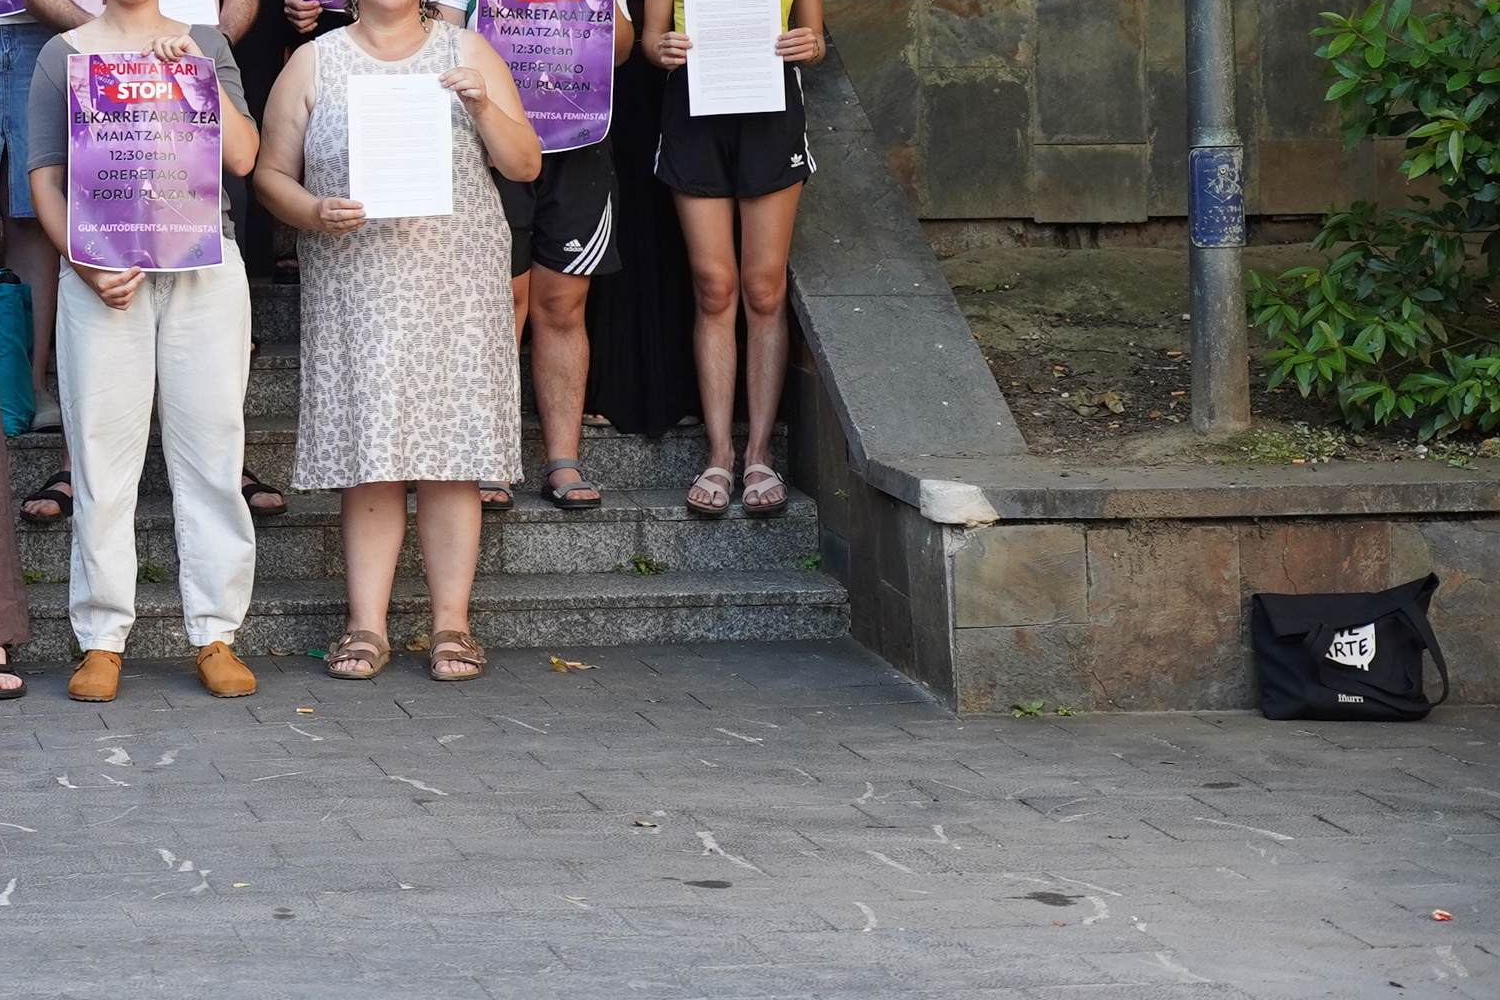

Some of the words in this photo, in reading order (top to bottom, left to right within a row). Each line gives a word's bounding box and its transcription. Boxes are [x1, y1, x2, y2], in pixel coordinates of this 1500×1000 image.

[481, 7, 613, 23] ELKARRETARATZEA
[500, 27, 571, 38] MAIATZAK
[575, 29, 591, 39] 30
[512, 44, 573, 56] 12:30etan
[117, 82, 173, 99] STOP!
[536, 80, 591, 91] PLAZAN
[74, 110, 219, 125] ELKARRETARATZEA
[563, 111, 607, 121] FEMINISTA!
[96, 130, 173, 142] MAIATZAK
[177, 131, 194, 142] 30
[109, 150, 176, 161] 12:30etan
[98, 169, 188, 181] ORERETAKO
[139, 189, 196, 201] PLAZAN
[78, 223, 98, 232] GUK
[101, 223, 168, 233] AUTODEFENTSA
[170, 224, 217, 233] FEMINISTA!
